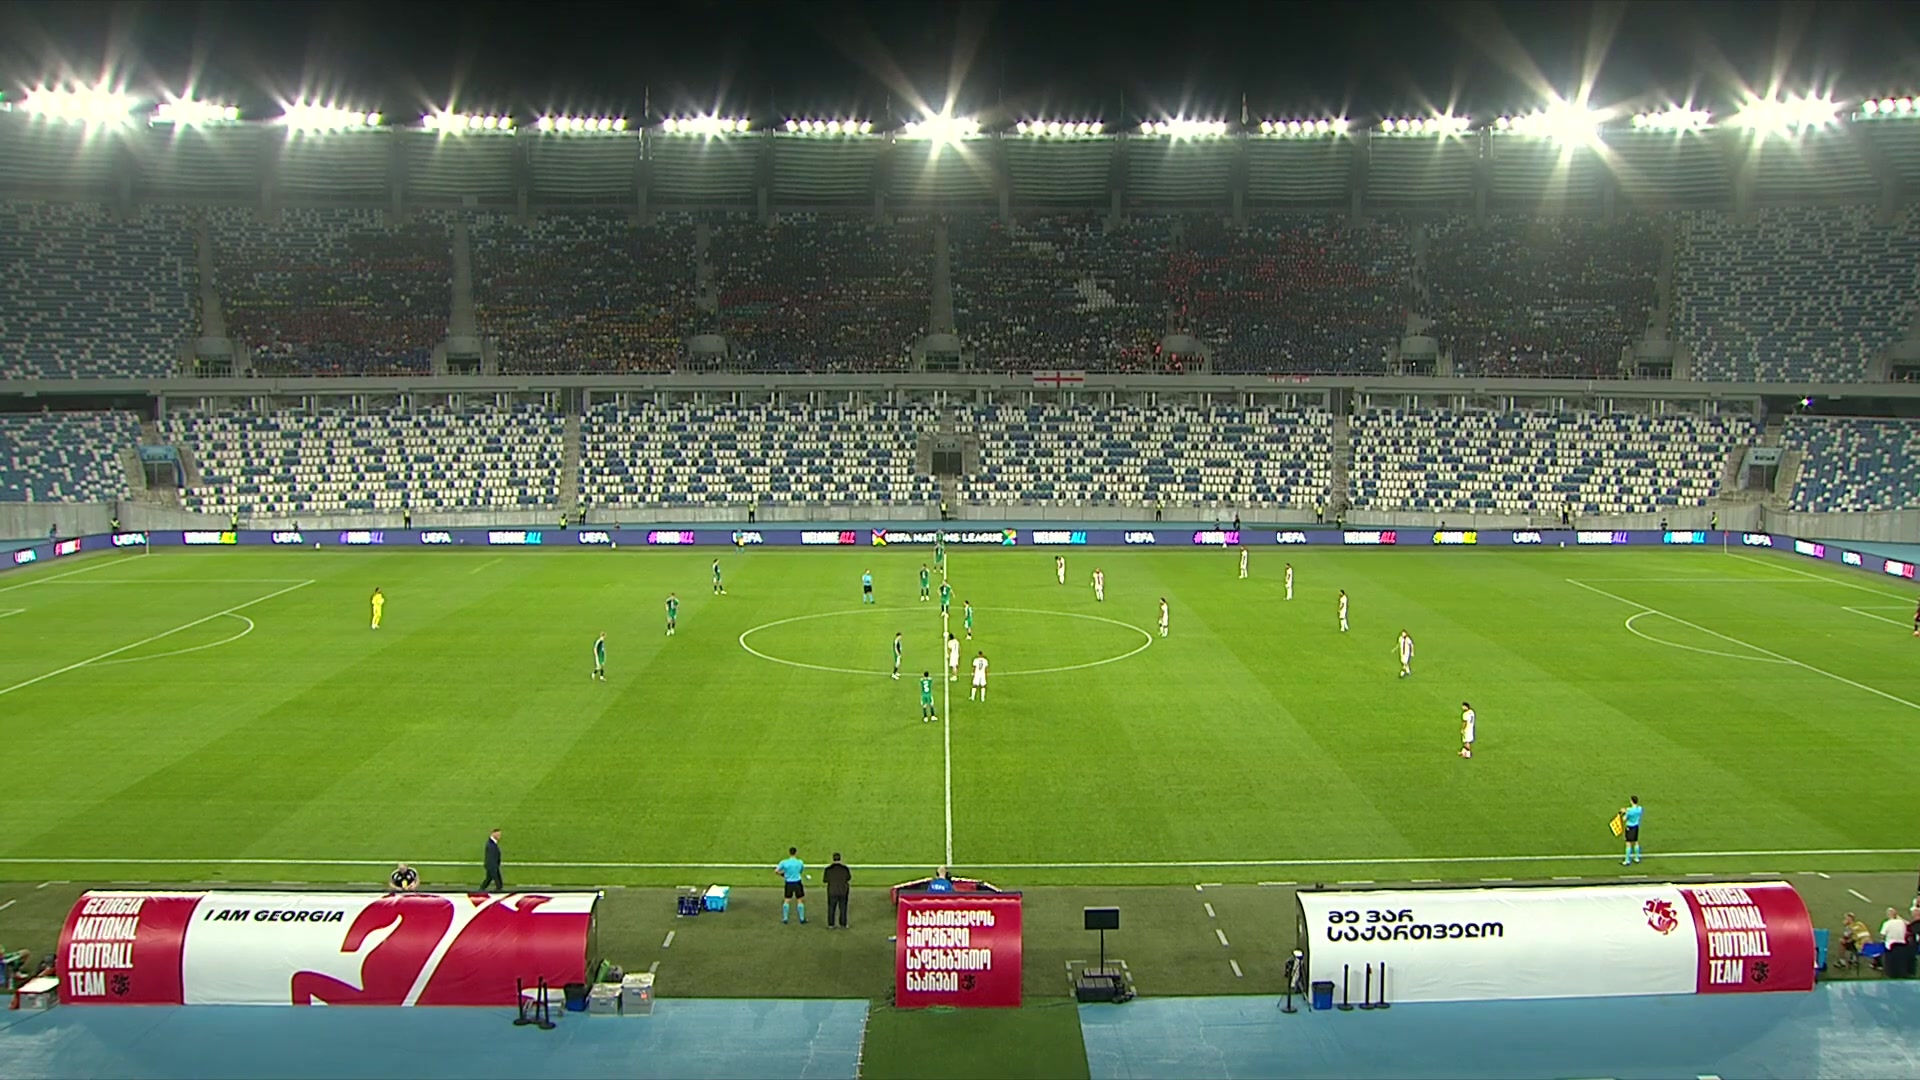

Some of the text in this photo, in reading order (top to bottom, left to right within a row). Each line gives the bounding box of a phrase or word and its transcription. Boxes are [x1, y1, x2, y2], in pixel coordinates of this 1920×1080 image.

[112, 532, 147, 546] UEFA
[272, 532, 303, 544] UEFA
[420, 532, 452, 544] UEFA
[578, 532, 610, 544] UEFA
[885, 532, 1003, 543] UEFA NATINS LEAGUE
[1124, 532, 1156, 544] UEFA
[1276, 532, 1307, 544] UEFA
[1512, 532, 1542, 544] UEFA
[1743, 533, 1773, 547] UEFA
[1692, 888, 1753, 905] GEORGIA
[82, 897, 146, 916] GEORGIA
[204, 909, 345, 923] I AM GEORGIA
[907, 910, 995, 927] საქართველოს
[1328, 909, 1414, 924] მე ვარ
[1701, 907, 1767, 930] NATIONAL
[72, 917, 139, 940] NATIONAL
[1327, 922, 1504, 942] საქართველო
[906, 927, 970, 948] ეროვნული
[1707, 931, 1771, 957] FOOTBALL
[68, 943, 134, 969] FOOTBALL
[906, 948, 992, 970] საფეხბურთო
[1709, 959, 1744, 984] TEAM
[69, 972, 106, 997] TEAM
[906, 971, 959, 992] ნაკრები
